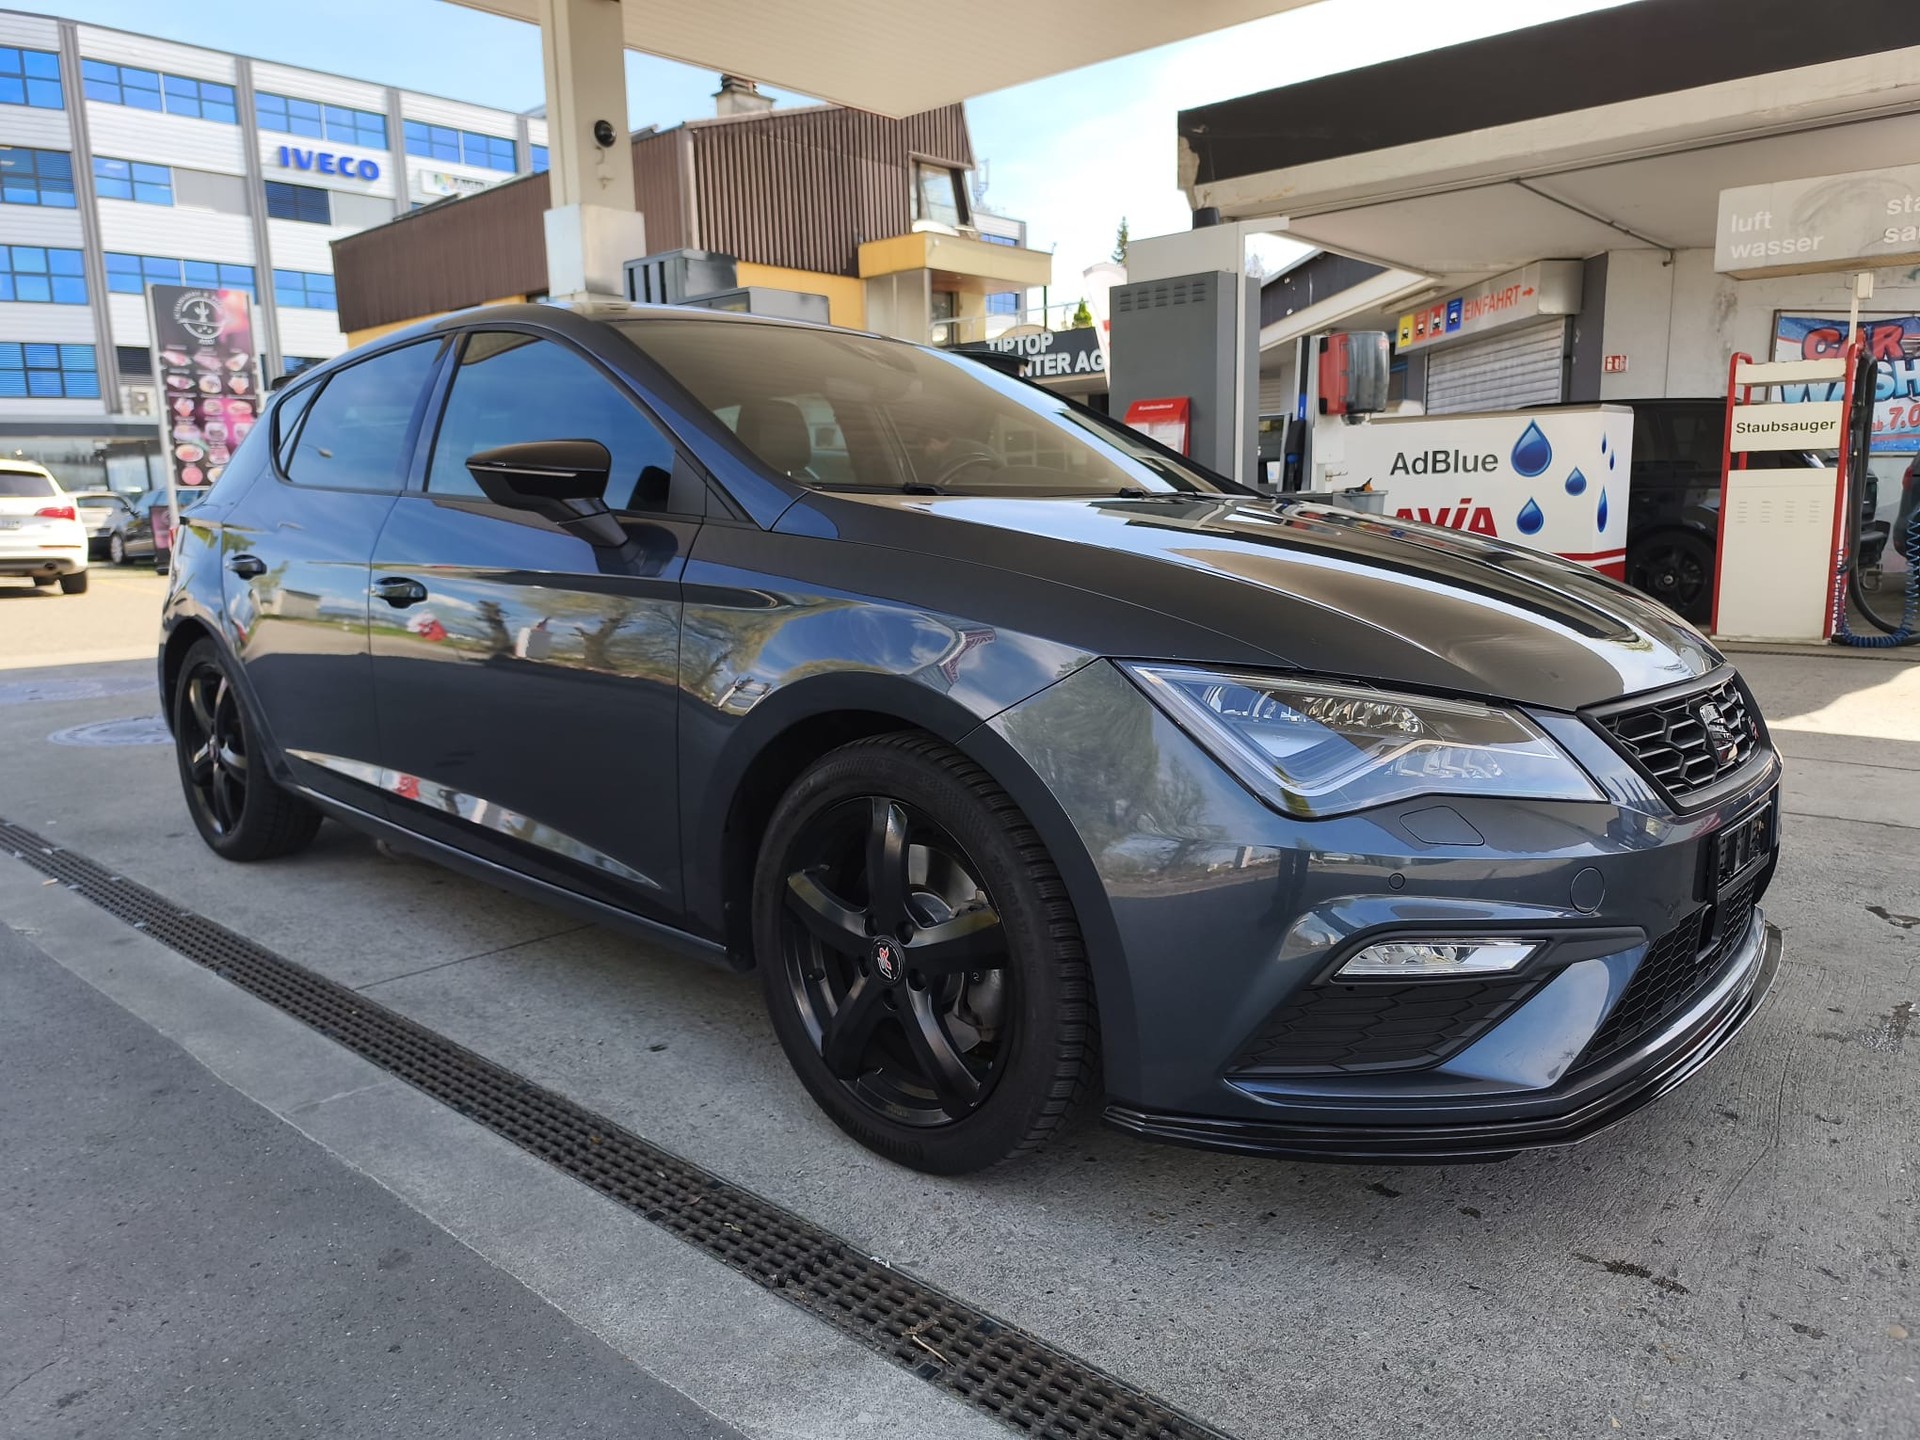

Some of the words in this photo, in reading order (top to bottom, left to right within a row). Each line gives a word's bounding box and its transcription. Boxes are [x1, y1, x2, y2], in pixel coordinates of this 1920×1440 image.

[279, 146, 380, 182] IVECO
[1731, 211, 1772, 233] luft
[1731, 235, 1824, 259] wasser
[1464, 284, 1521, 321] EINFAHRT
[986, 332, 1054, 356] TIPTOP
[1074, 348, 1105, 373] AG
[1736, 421, 1837, 434] Staubsauger
[1389, 449, 1499, 476] AdBlue
